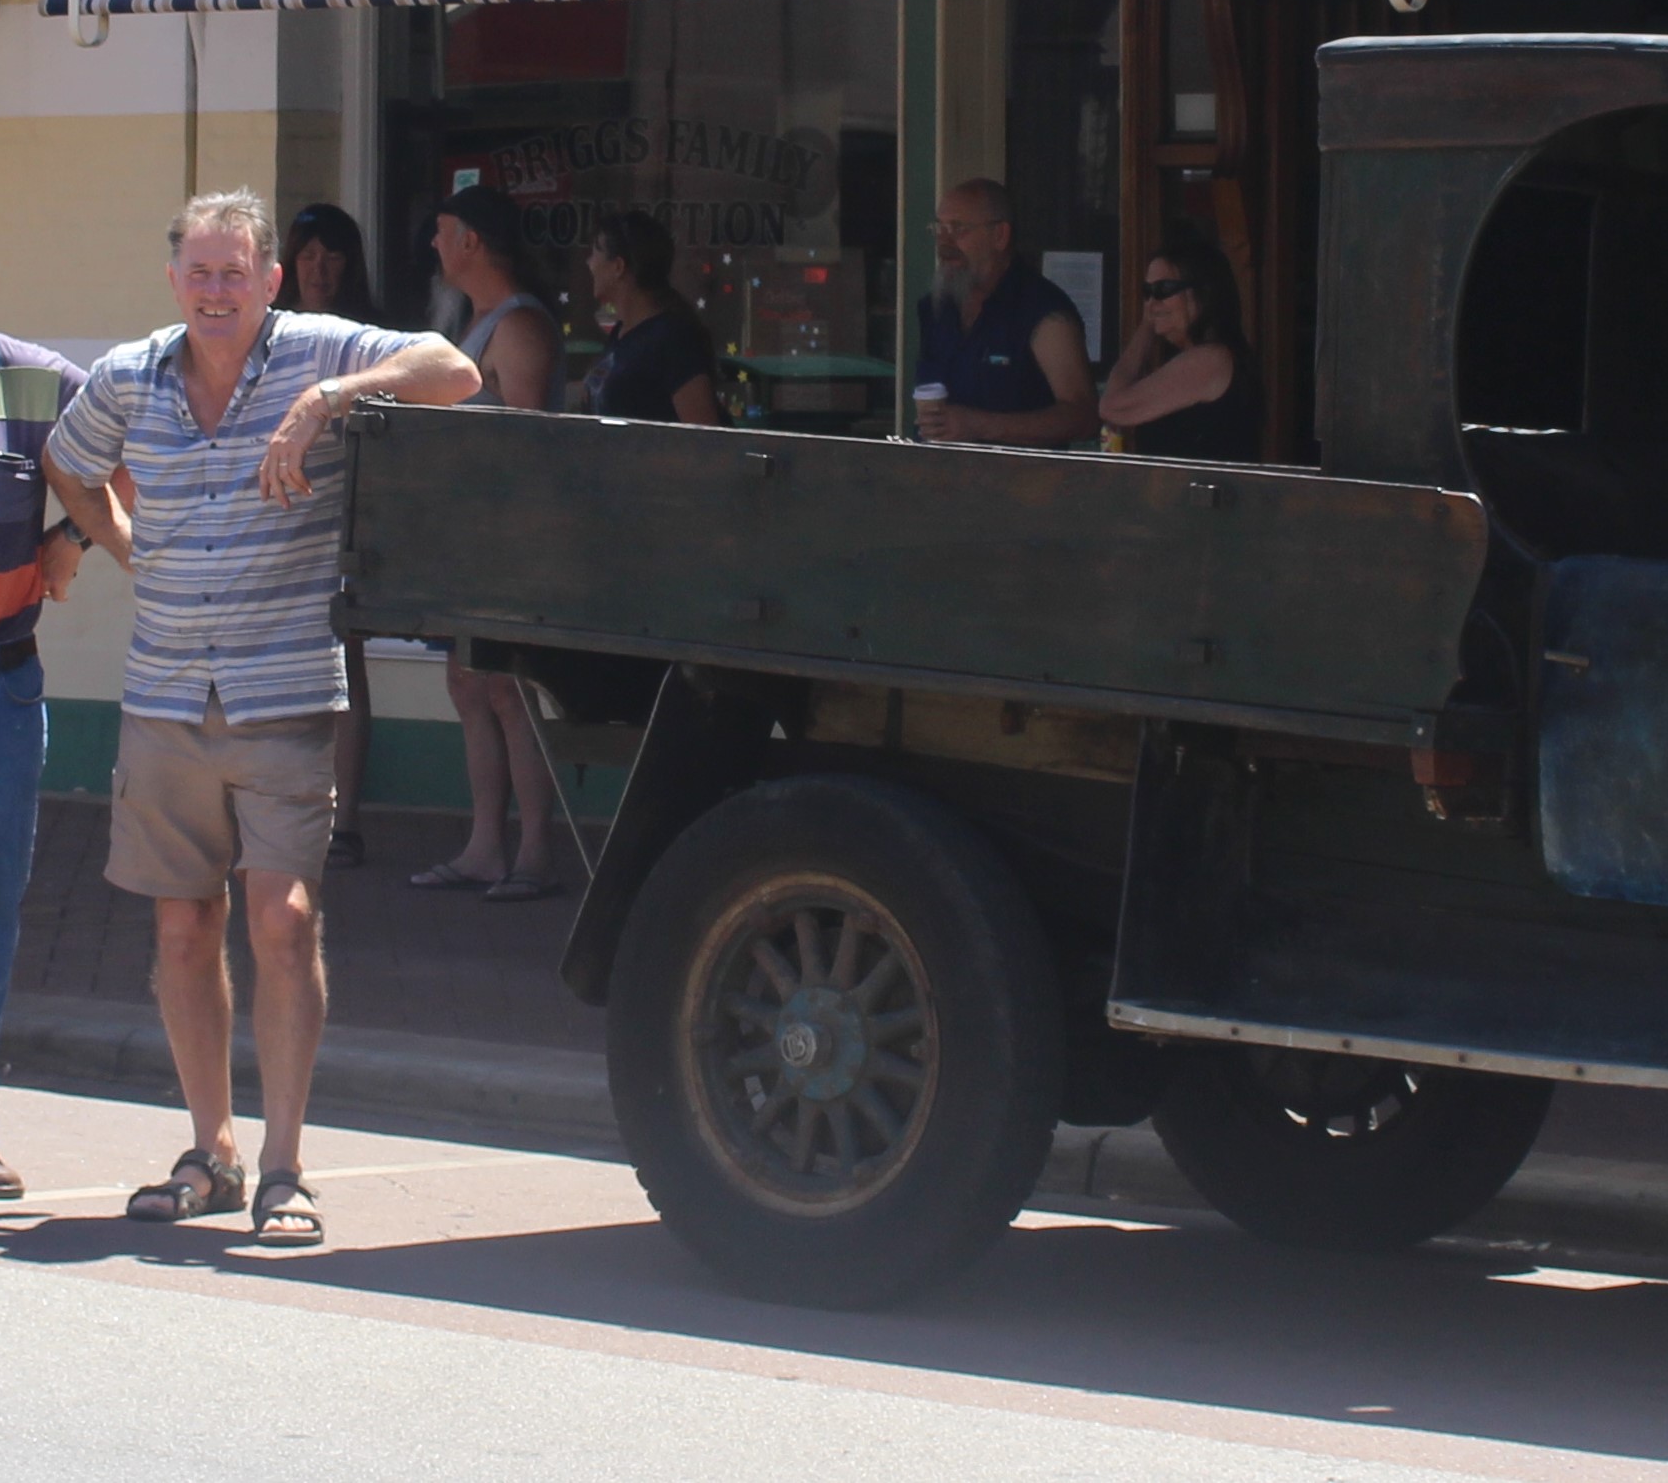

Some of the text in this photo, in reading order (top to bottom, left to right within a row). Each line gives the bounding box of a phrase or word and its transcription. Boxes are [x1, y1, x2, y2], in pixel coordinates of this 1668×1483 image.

[492, 118, 822, 191] BRIGGS FAMILY
[520, 199, 787, 247] COLTION
